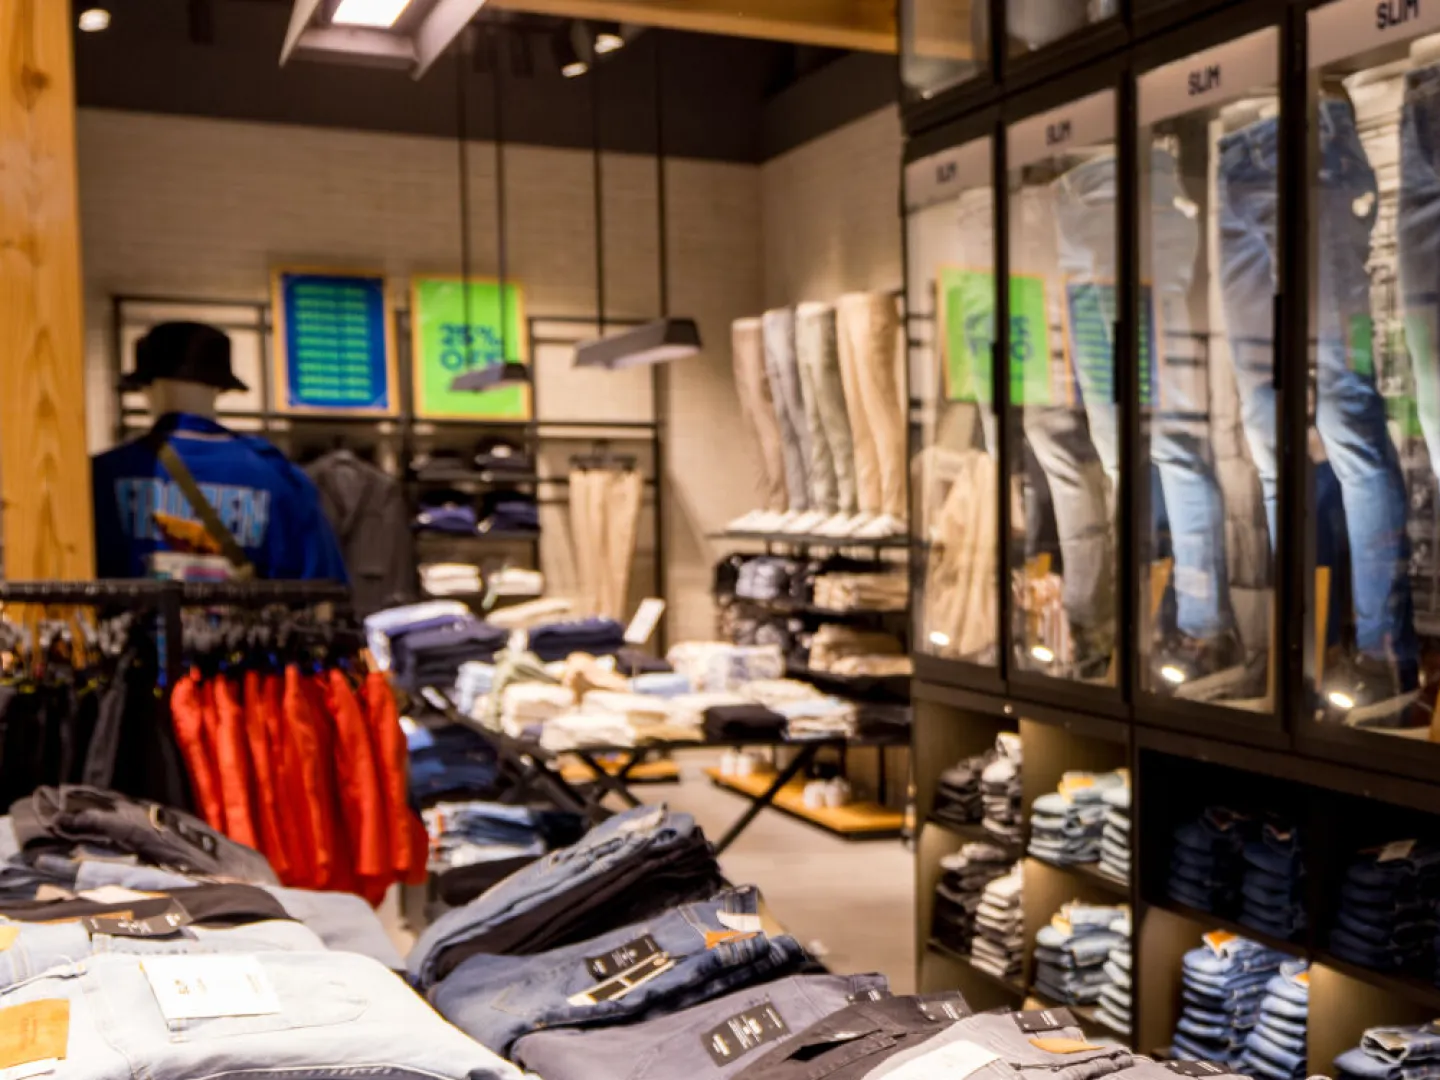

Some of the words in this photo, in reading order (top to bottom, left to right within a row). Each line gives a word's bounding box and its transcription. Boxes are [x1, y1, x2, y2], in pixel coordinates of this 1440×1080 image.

[1376, 0, 1419, 31] SLIM
[1187, 64, 1221, 96] SLIM
[1046, 120, 1071, 146] SLIM
